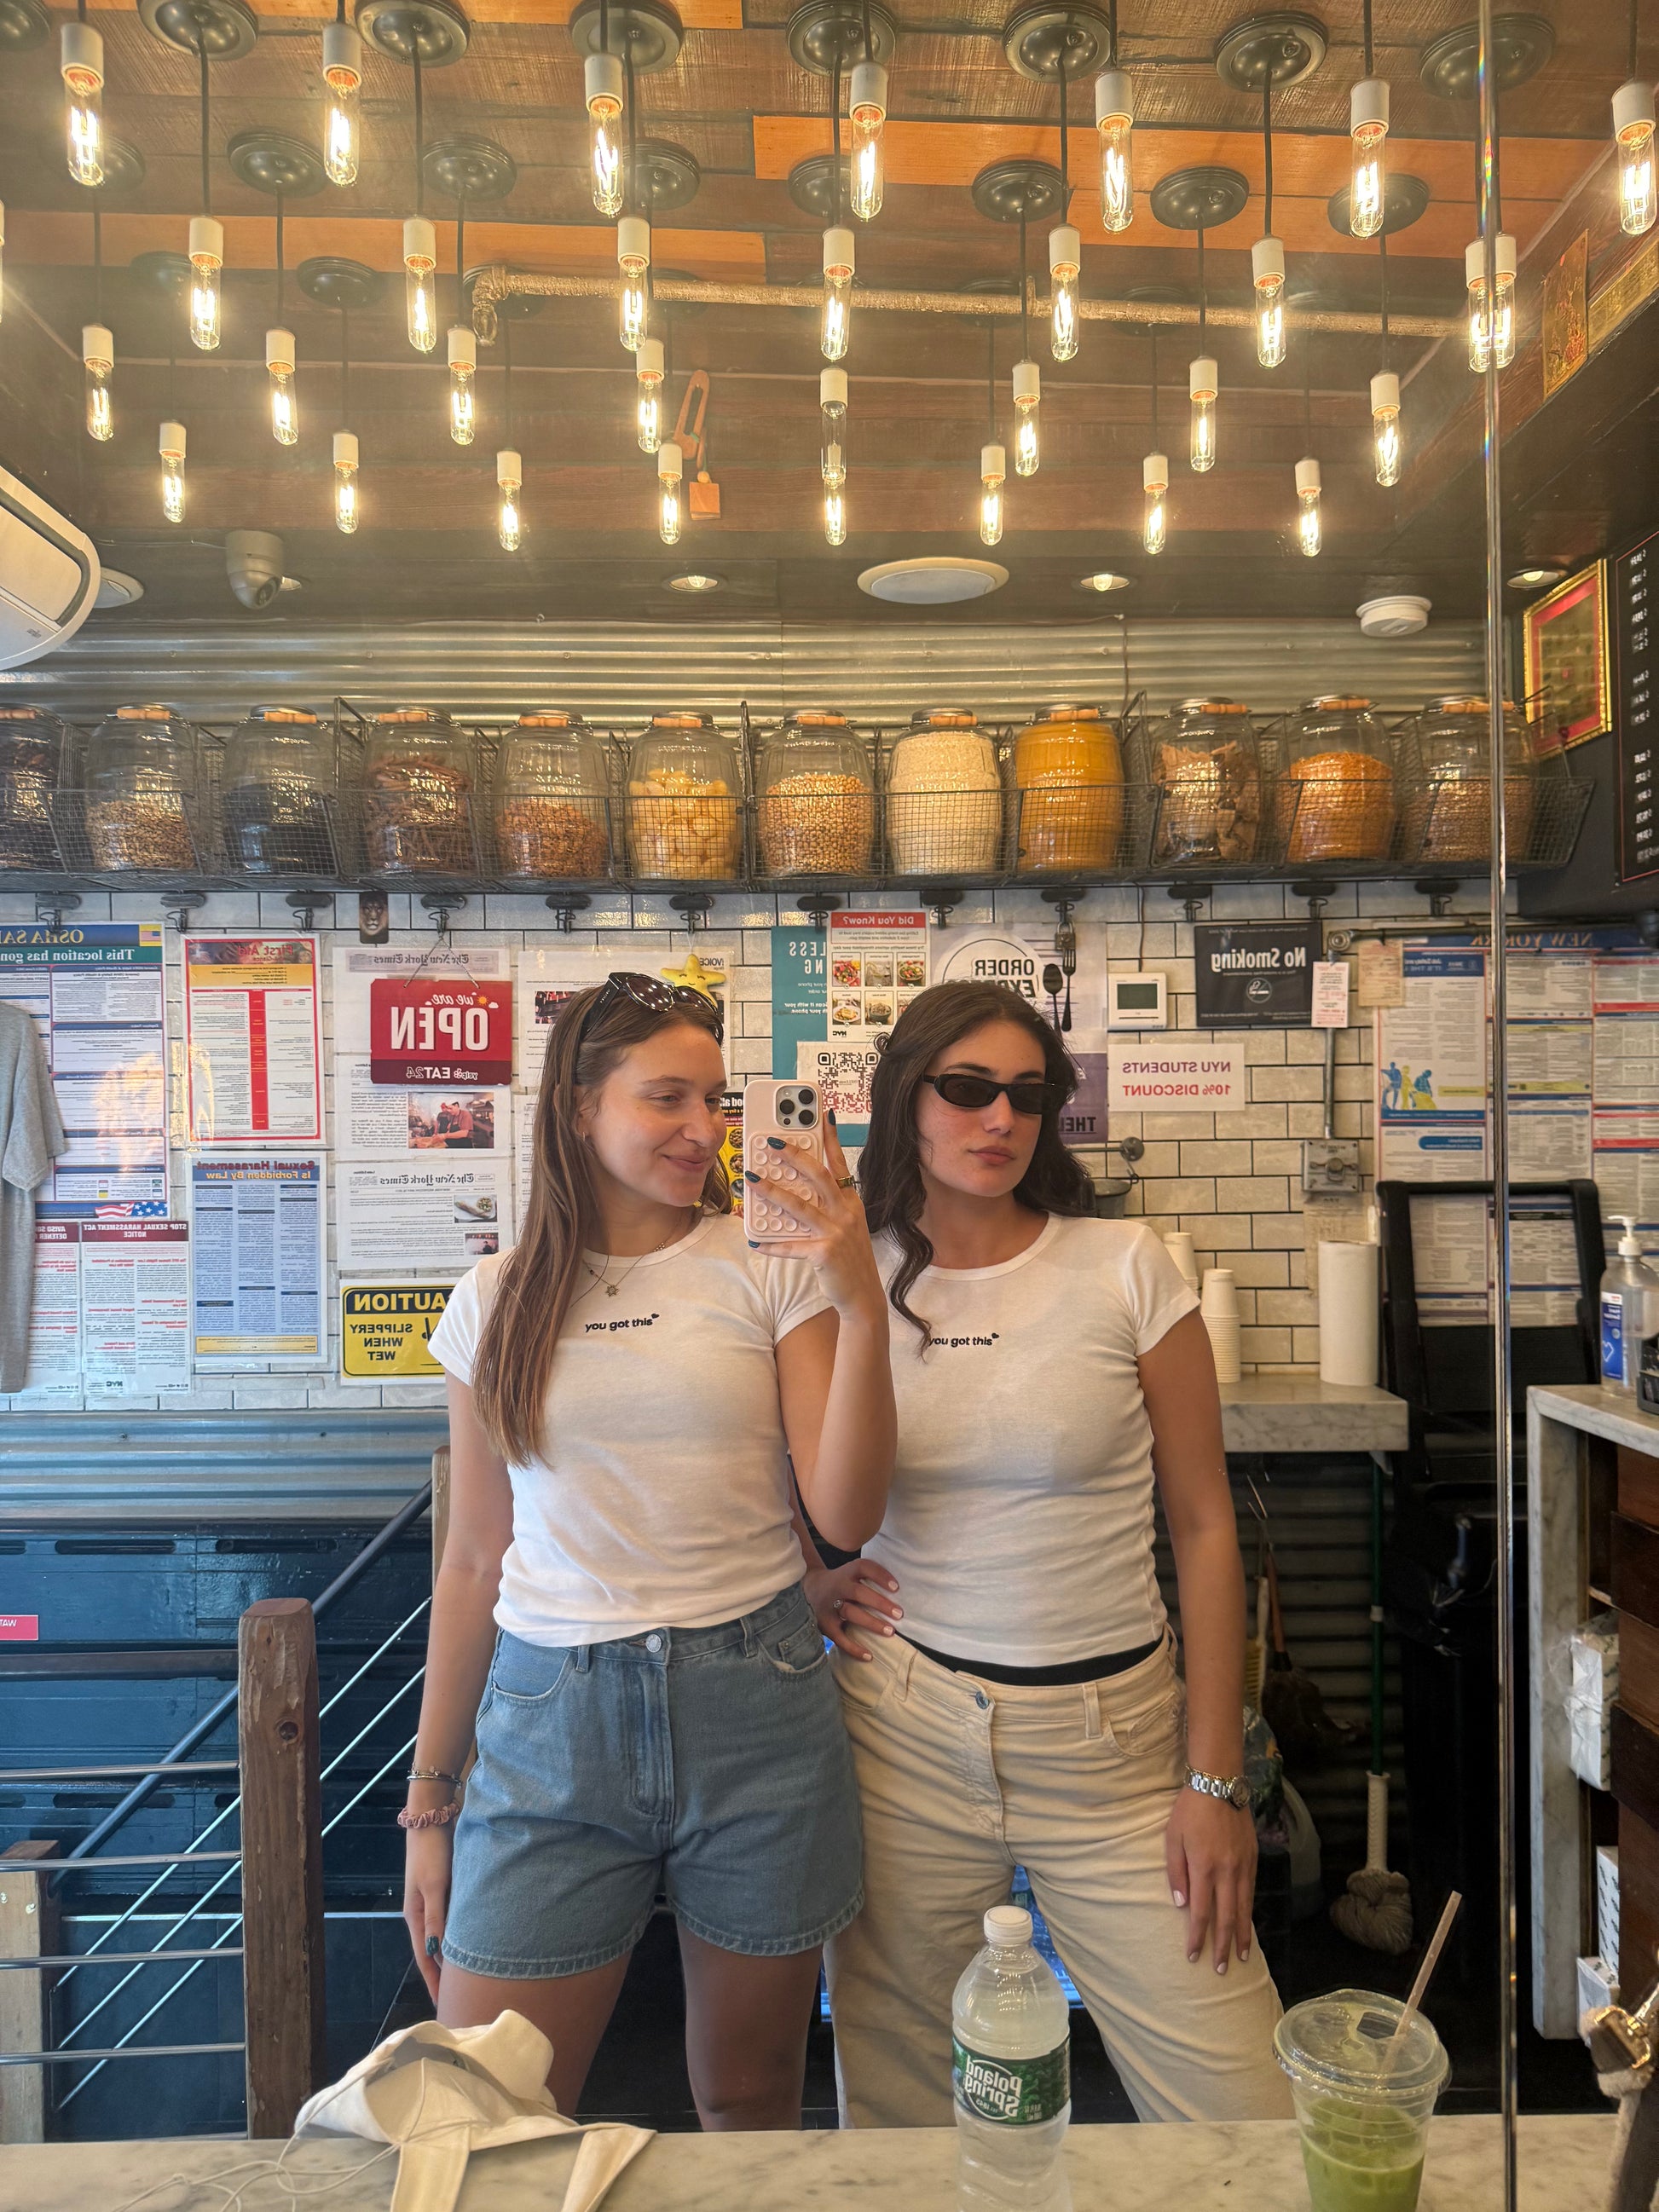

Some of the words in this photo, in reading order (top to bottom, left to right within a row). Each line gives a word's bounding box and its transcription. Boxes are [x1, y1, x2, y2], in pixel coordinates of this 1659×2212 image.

[585, 1323, 606, 1332] you
[610, 1320, 629, 1331] got
[632, 1318, 653, 1327] this
[928, 1337, 948, 1347] you
[951, 1337, 970, 1348] got
[972, 1337, 992, 1346] this
